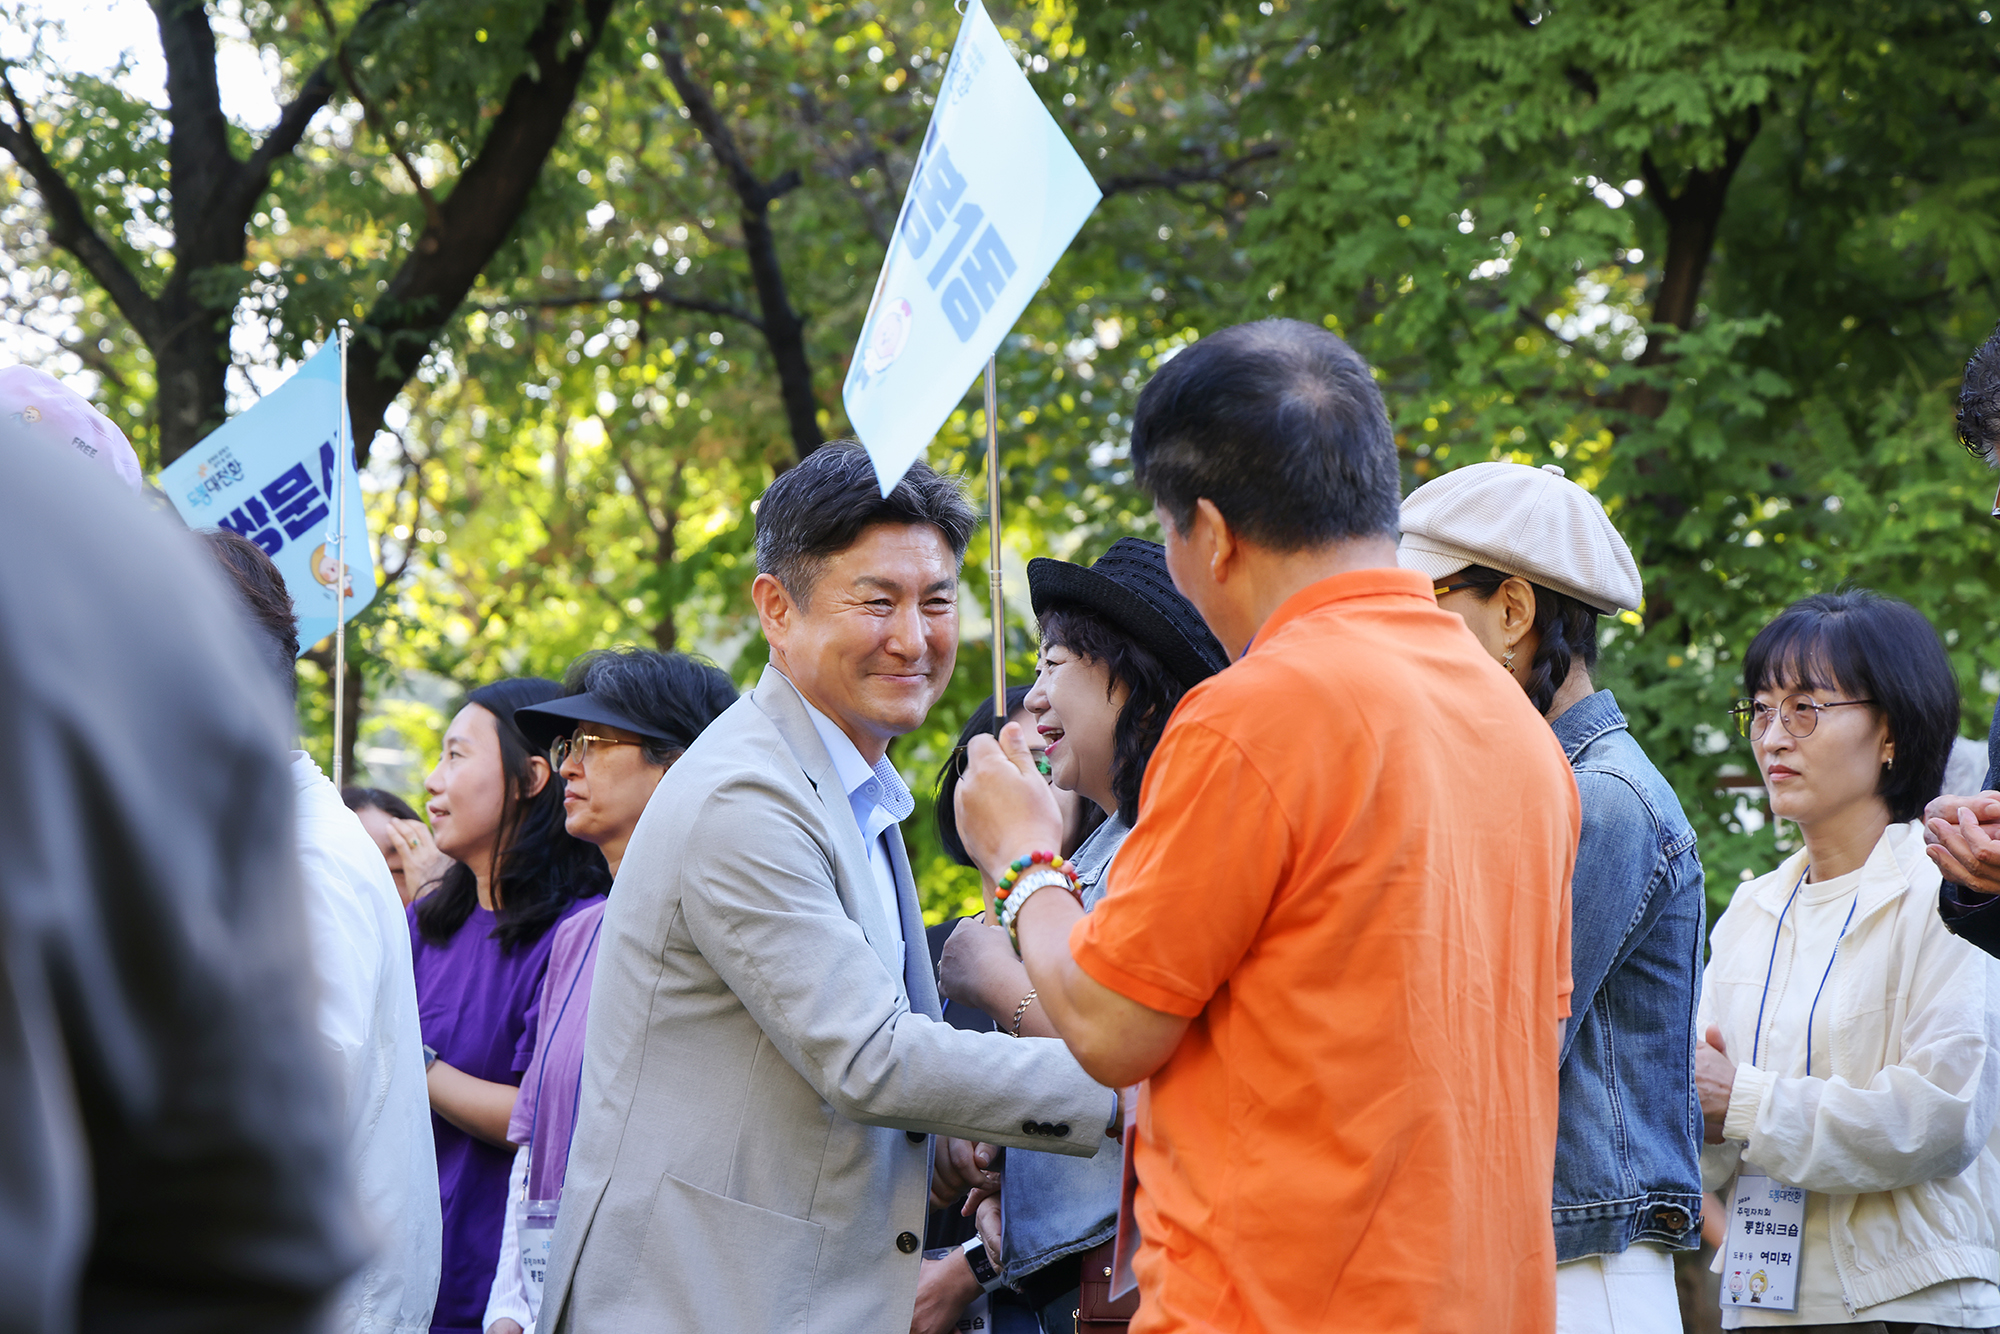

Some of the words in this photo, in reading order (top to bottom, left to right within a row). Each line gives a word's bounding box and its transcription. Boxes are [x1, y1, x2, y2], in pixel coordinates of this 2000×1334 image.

[71, 436, 98, 459] FREE
[1737, 1207, 1771, 1217] 주민자치회
[1744, 1220, 1799, 1237] 통합워크숍
[1760, 1251, 1792, 1266] 여미화
